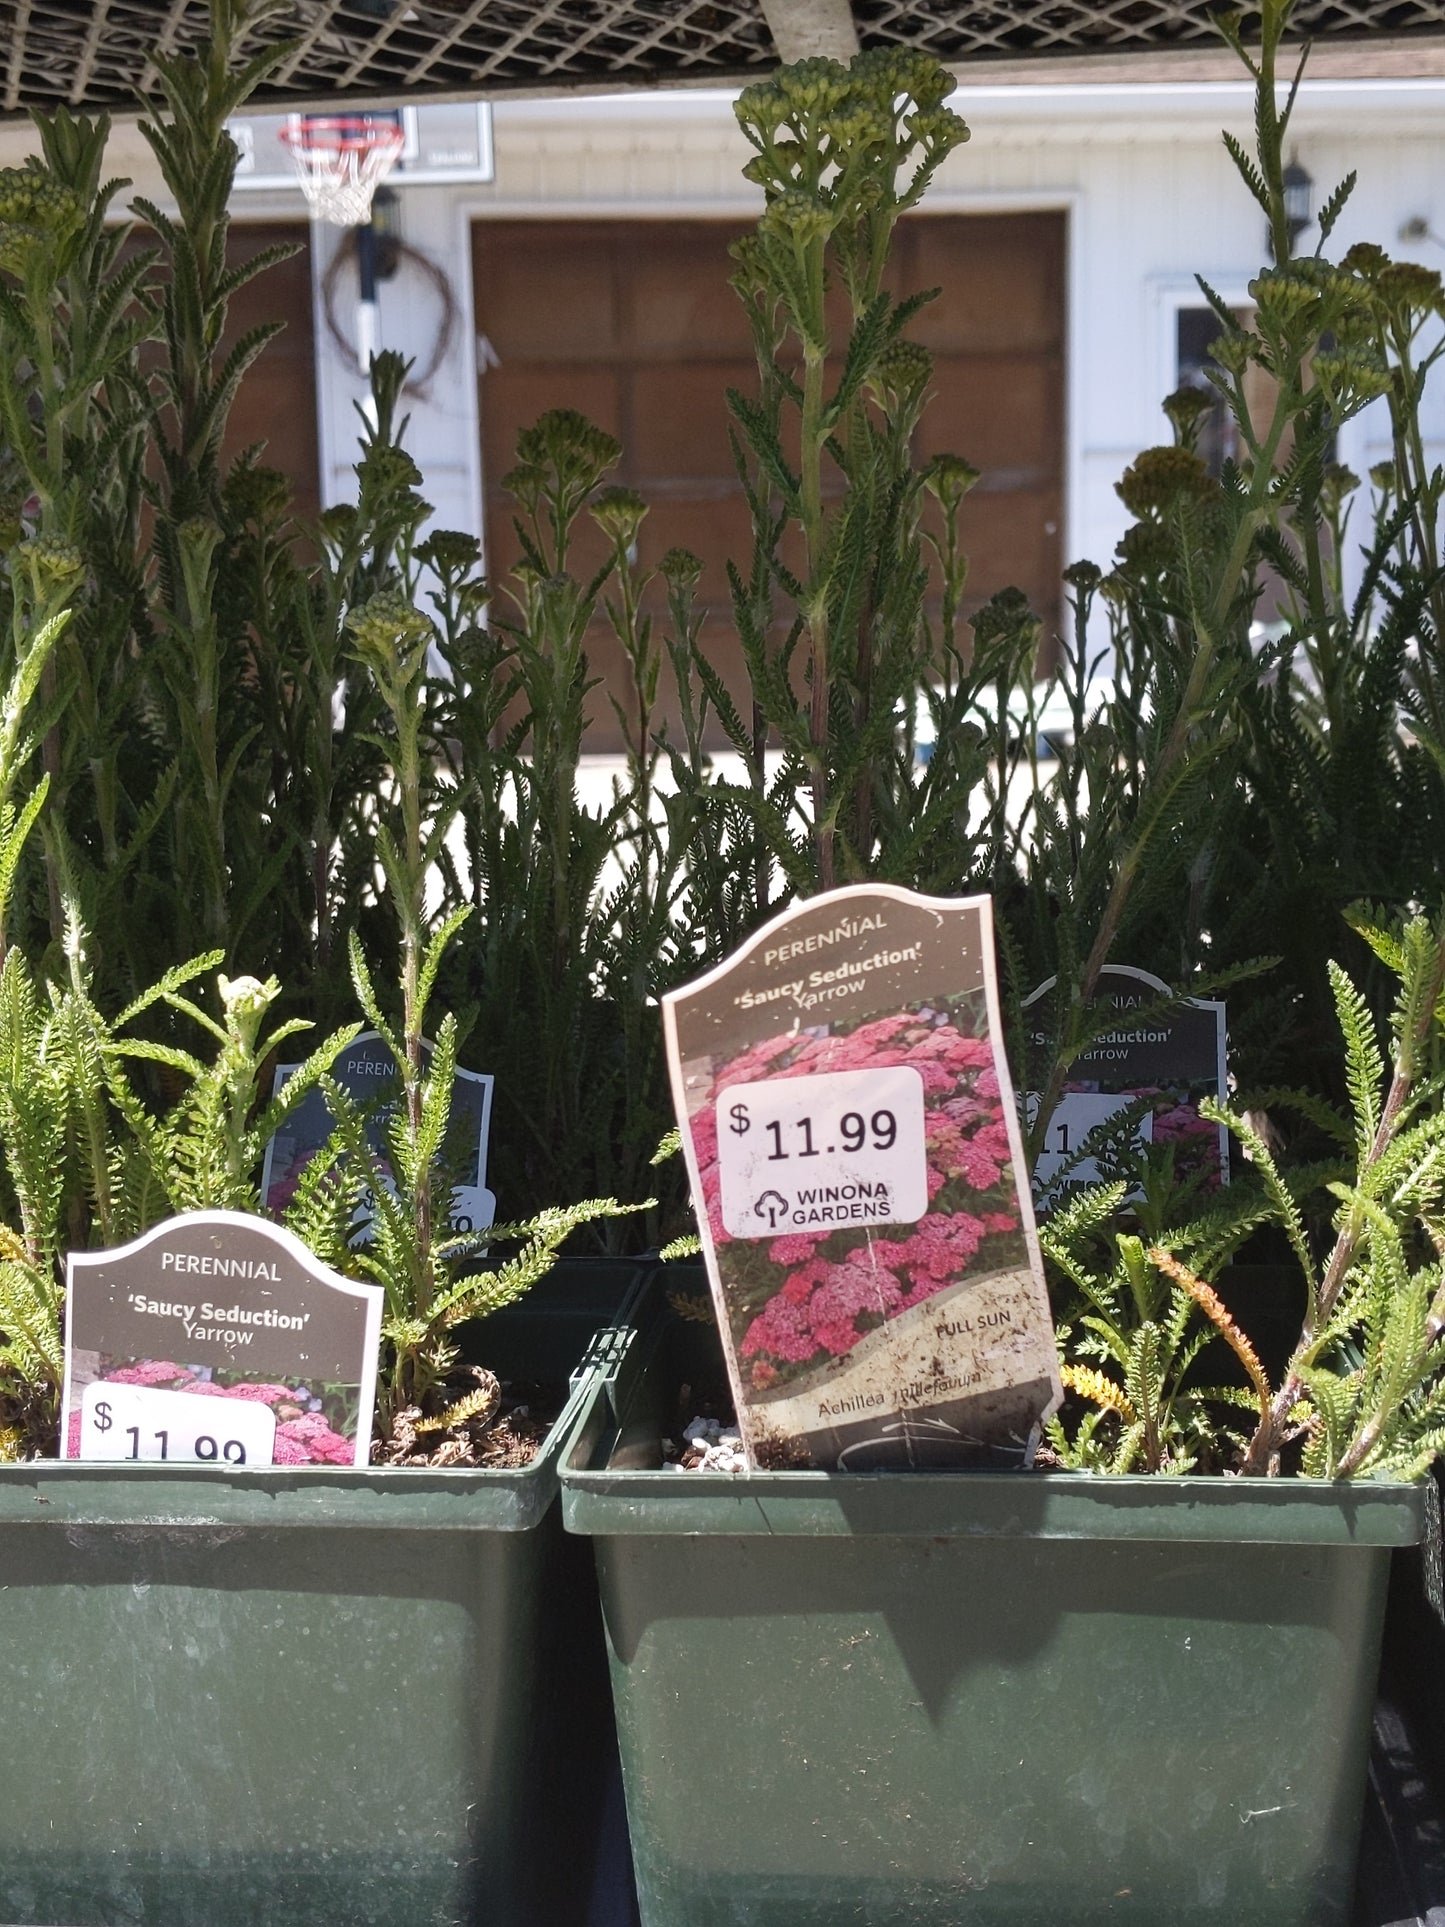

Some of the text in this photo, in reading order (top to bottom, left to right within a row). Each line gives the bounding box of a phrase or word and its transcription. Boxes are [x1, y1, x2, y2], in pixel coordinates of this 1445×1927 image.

[763, 913, 887, 966] PERENNIAL
[794, 978, 866, 1010] Yarrow
[1092, 1028, 1172, 1044] eduction'
[797, 1182, 888, 1206] WINONA
[792, 1201, 891, 1225] GARDENS
[161, 1253, 281, 1281] PERENNIAL
[128, 1294, 310, 1330] 'Saucy Seduction'
[977, 1310, 1011, 1329] SUN
[183, 1322, 254, 1345] Yarrow
